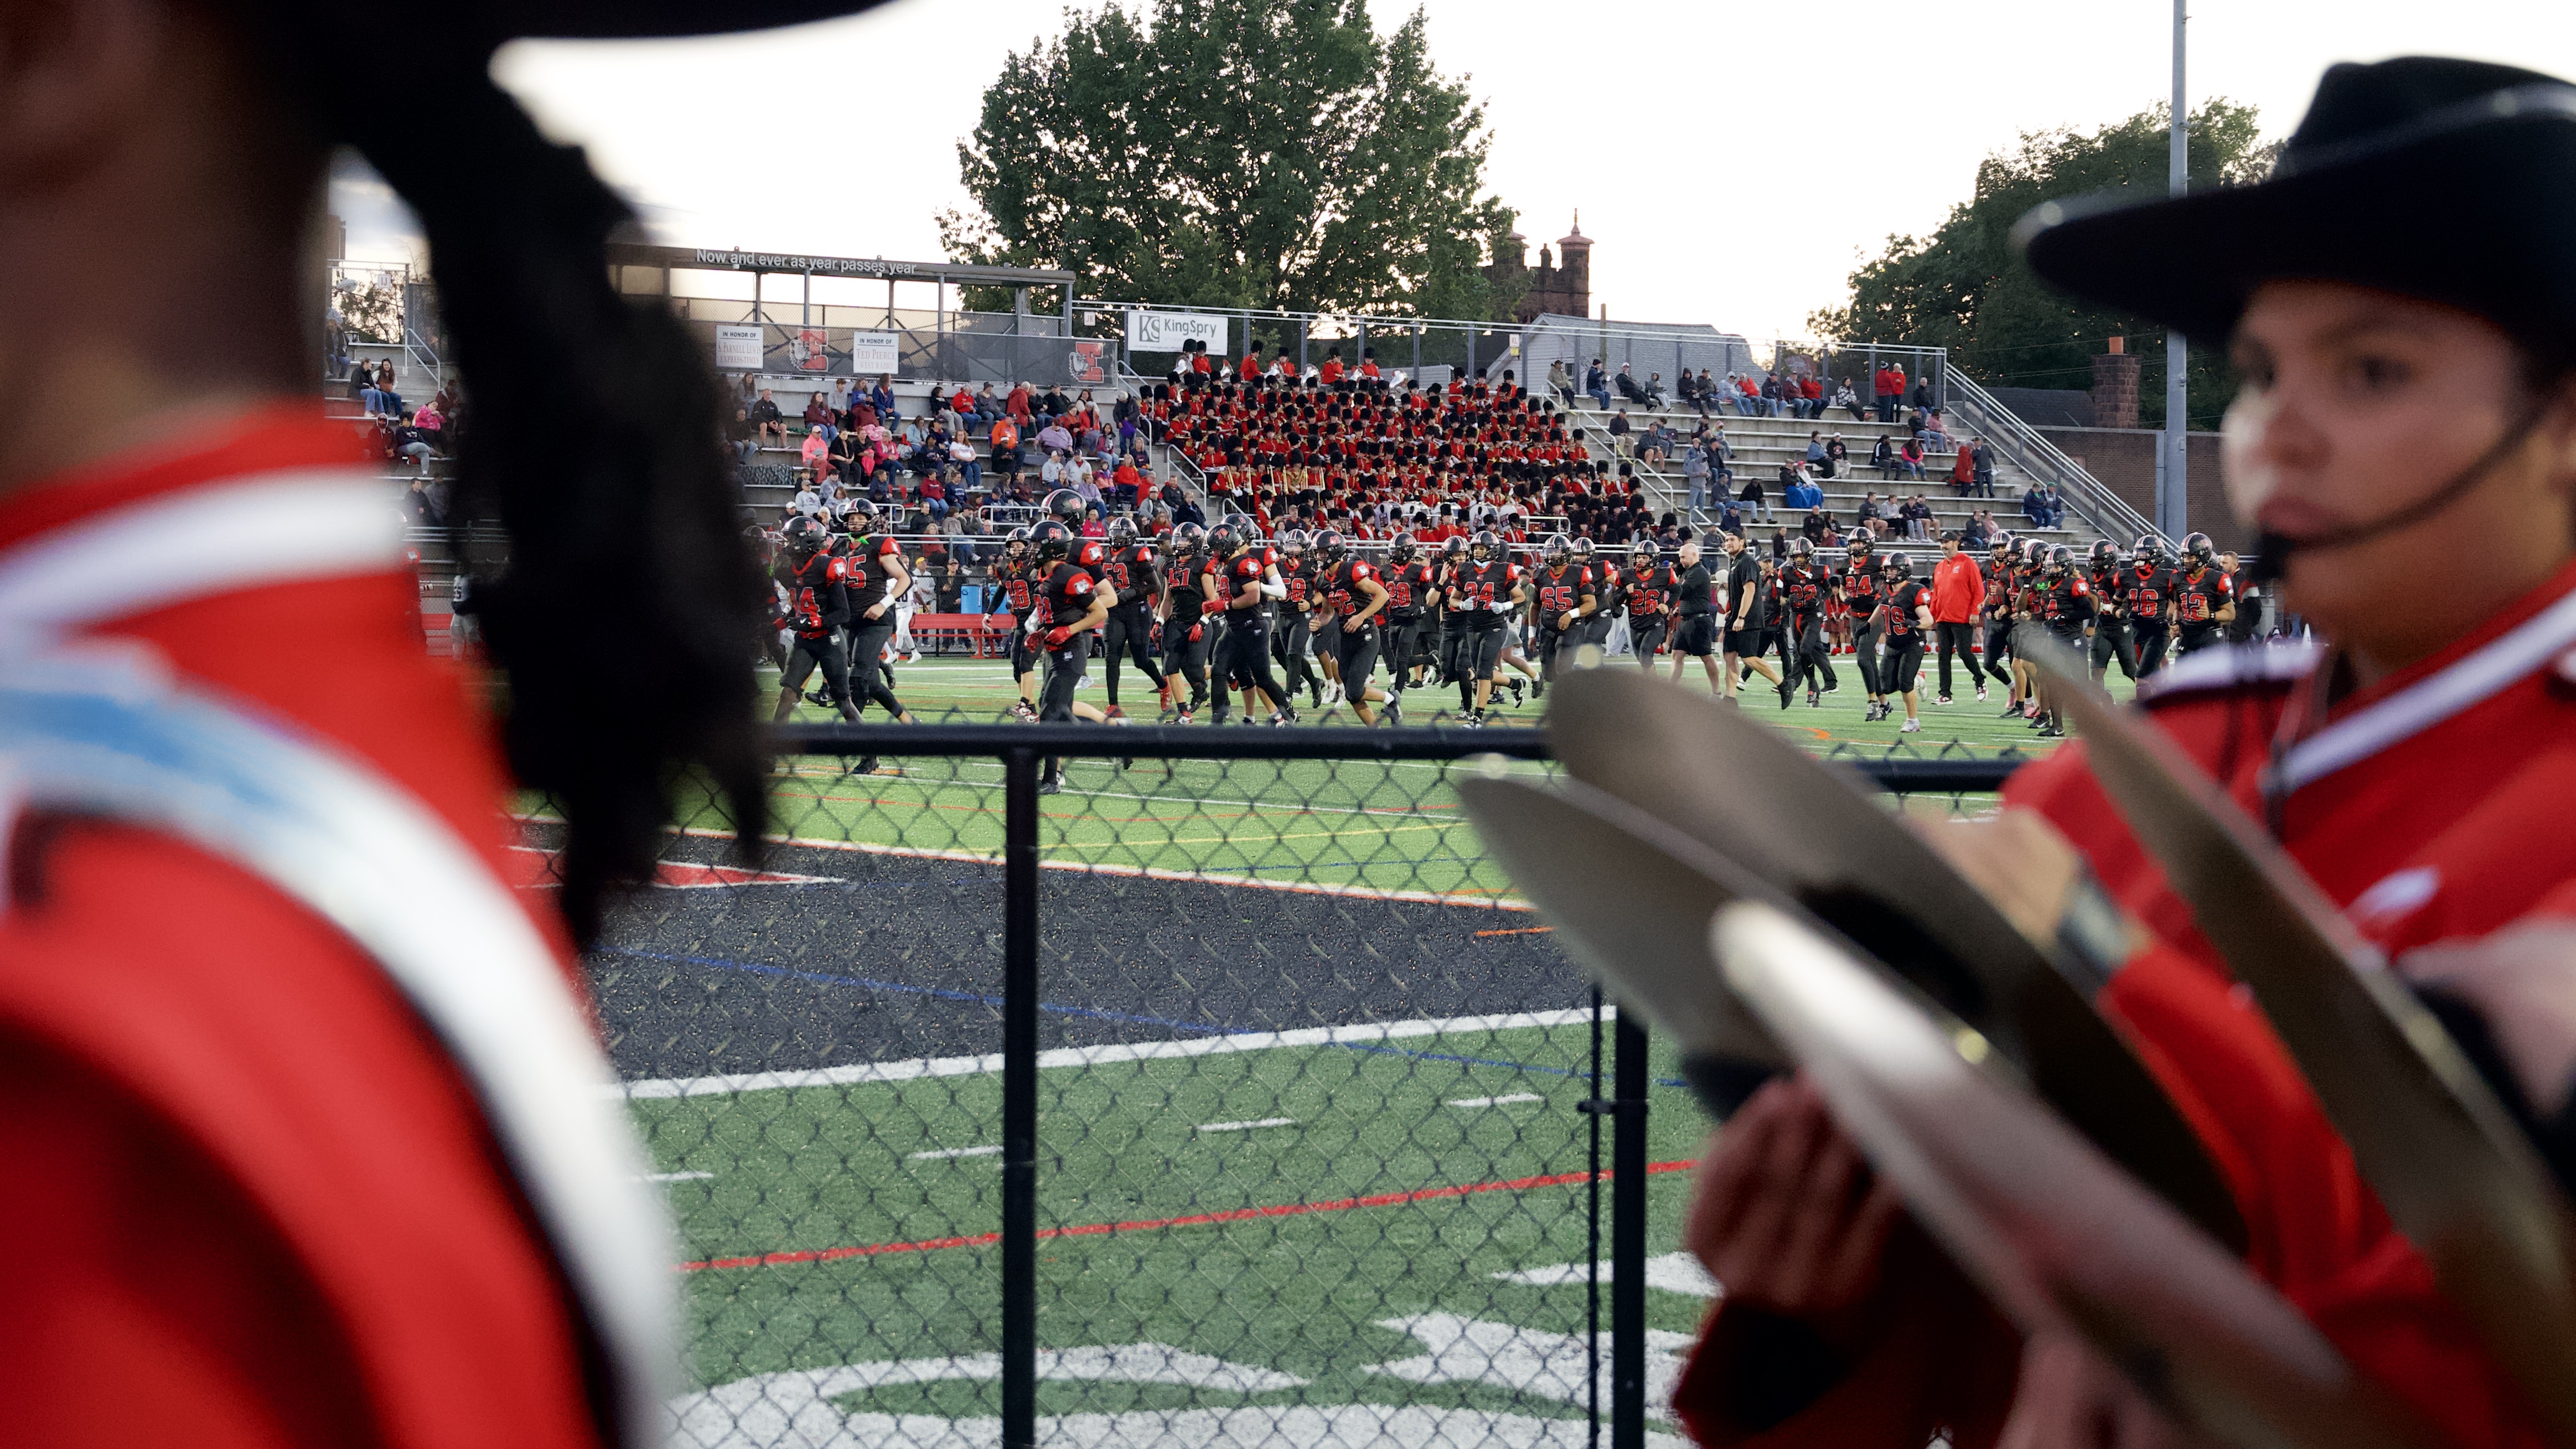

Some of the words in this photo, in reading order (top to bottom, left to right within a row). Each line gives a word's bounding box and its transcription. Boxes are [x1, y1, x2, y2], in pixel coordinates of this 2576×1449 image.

[696, 249, 727, 263] Now
[730, 252, 755, 265] and
[759, 255, 787, 266] ever
[790, 257, 805, 267] as
[809, 258, 837, 270] year
[841, 260, 886, 272] passes
[889, 263, 917, 275] year
[1086, 314, 1094, 323] JK
[1139, 315, 1160, 342] KS
[1165, 318, 1217, 338] KingSpry
[720, 355, 759, 364] EXPRESS-TIMES
[856, 349, 870, 359] TED
[872, 349, 896, 360] PIERCE
[1102, 562, 1130, 589] 53
[789, 586, 822, 618] 14
[1540, 586, 1574, 612] 65
[1631, 588, 1660, 616] 26
[2129, 588, 2159, 618] 16
[2180, 593, 2207, 622] 12
[1880, 604, 1908, 636] 79
